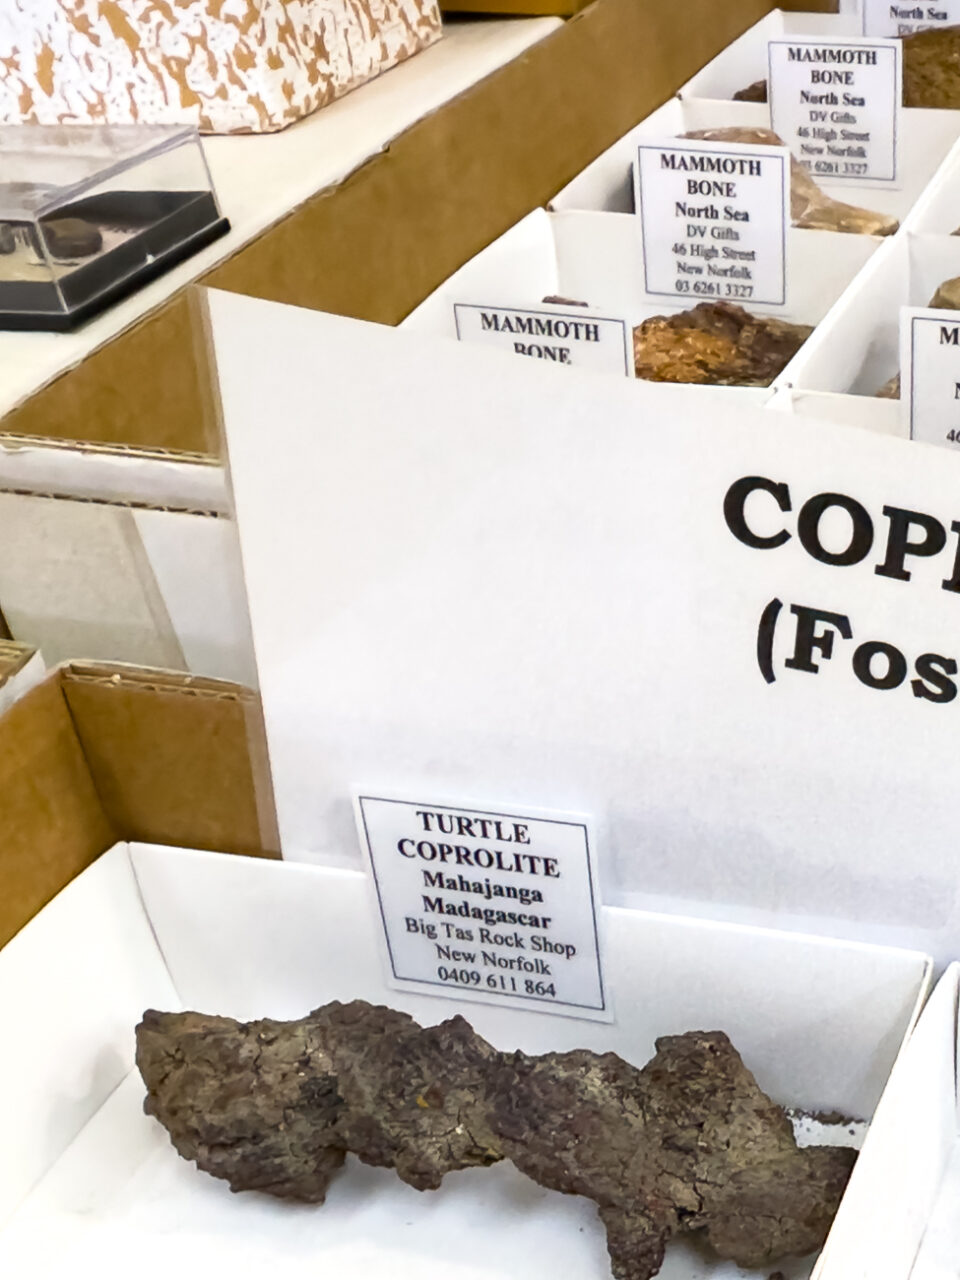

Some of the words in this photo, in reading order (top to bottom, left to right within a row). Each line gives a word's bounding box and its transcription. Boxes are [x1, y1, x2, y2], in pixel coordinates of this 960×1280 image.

[890, 5, 923, 19] North
[927, 8, 947, 20] Sea
[788, 48, 877, 65] MAMMOTH
[811, 70, 855, 85] BONE
[800, 90, 838, 106] North
[842, 93, 865, 106] Sea
[809, 110, 827, 122] DV
[661, 153, 761, 176] MAMMOTH
[687, 180, 736, 197] BONE
[675, 202, 719, 220] North
[724, 205, 749, 221] Sea
[687, 225, 707, 237] DV
[711, 227, 740, 240] Gifts
[672, 243, 686, 255] 46
[690, 244, 719, 261] High
[722, 247, 756, 261] Street
[677, 261, 703, 274] New
[707, 264, 752, 279] Norfolk
[675, 280, 689, 292] 03
[693, 282, 721, 294] 6261
[481, 313, 600, 342] MAMMOTH
[416, 811, 531, 844] TURTLE
[397, 838, 561, 878] COPROLITE
[421, 870, 544, 905] Mahajanga
[421, 896, 552, 929] Madagascar
[405, 917, 437, 939] Big
[441, 922, 473, 941] Tas
[479, 927, 524, 949] Rock
[531, 935, 576, 959] Shop
[435, 943, 476, 964] New
[481, 952, 552, 976] Norfolk
[438, 966, 481, 986] 0409
[487, 974, 517, 991] 611
[525, 979, 556, 998] 864
